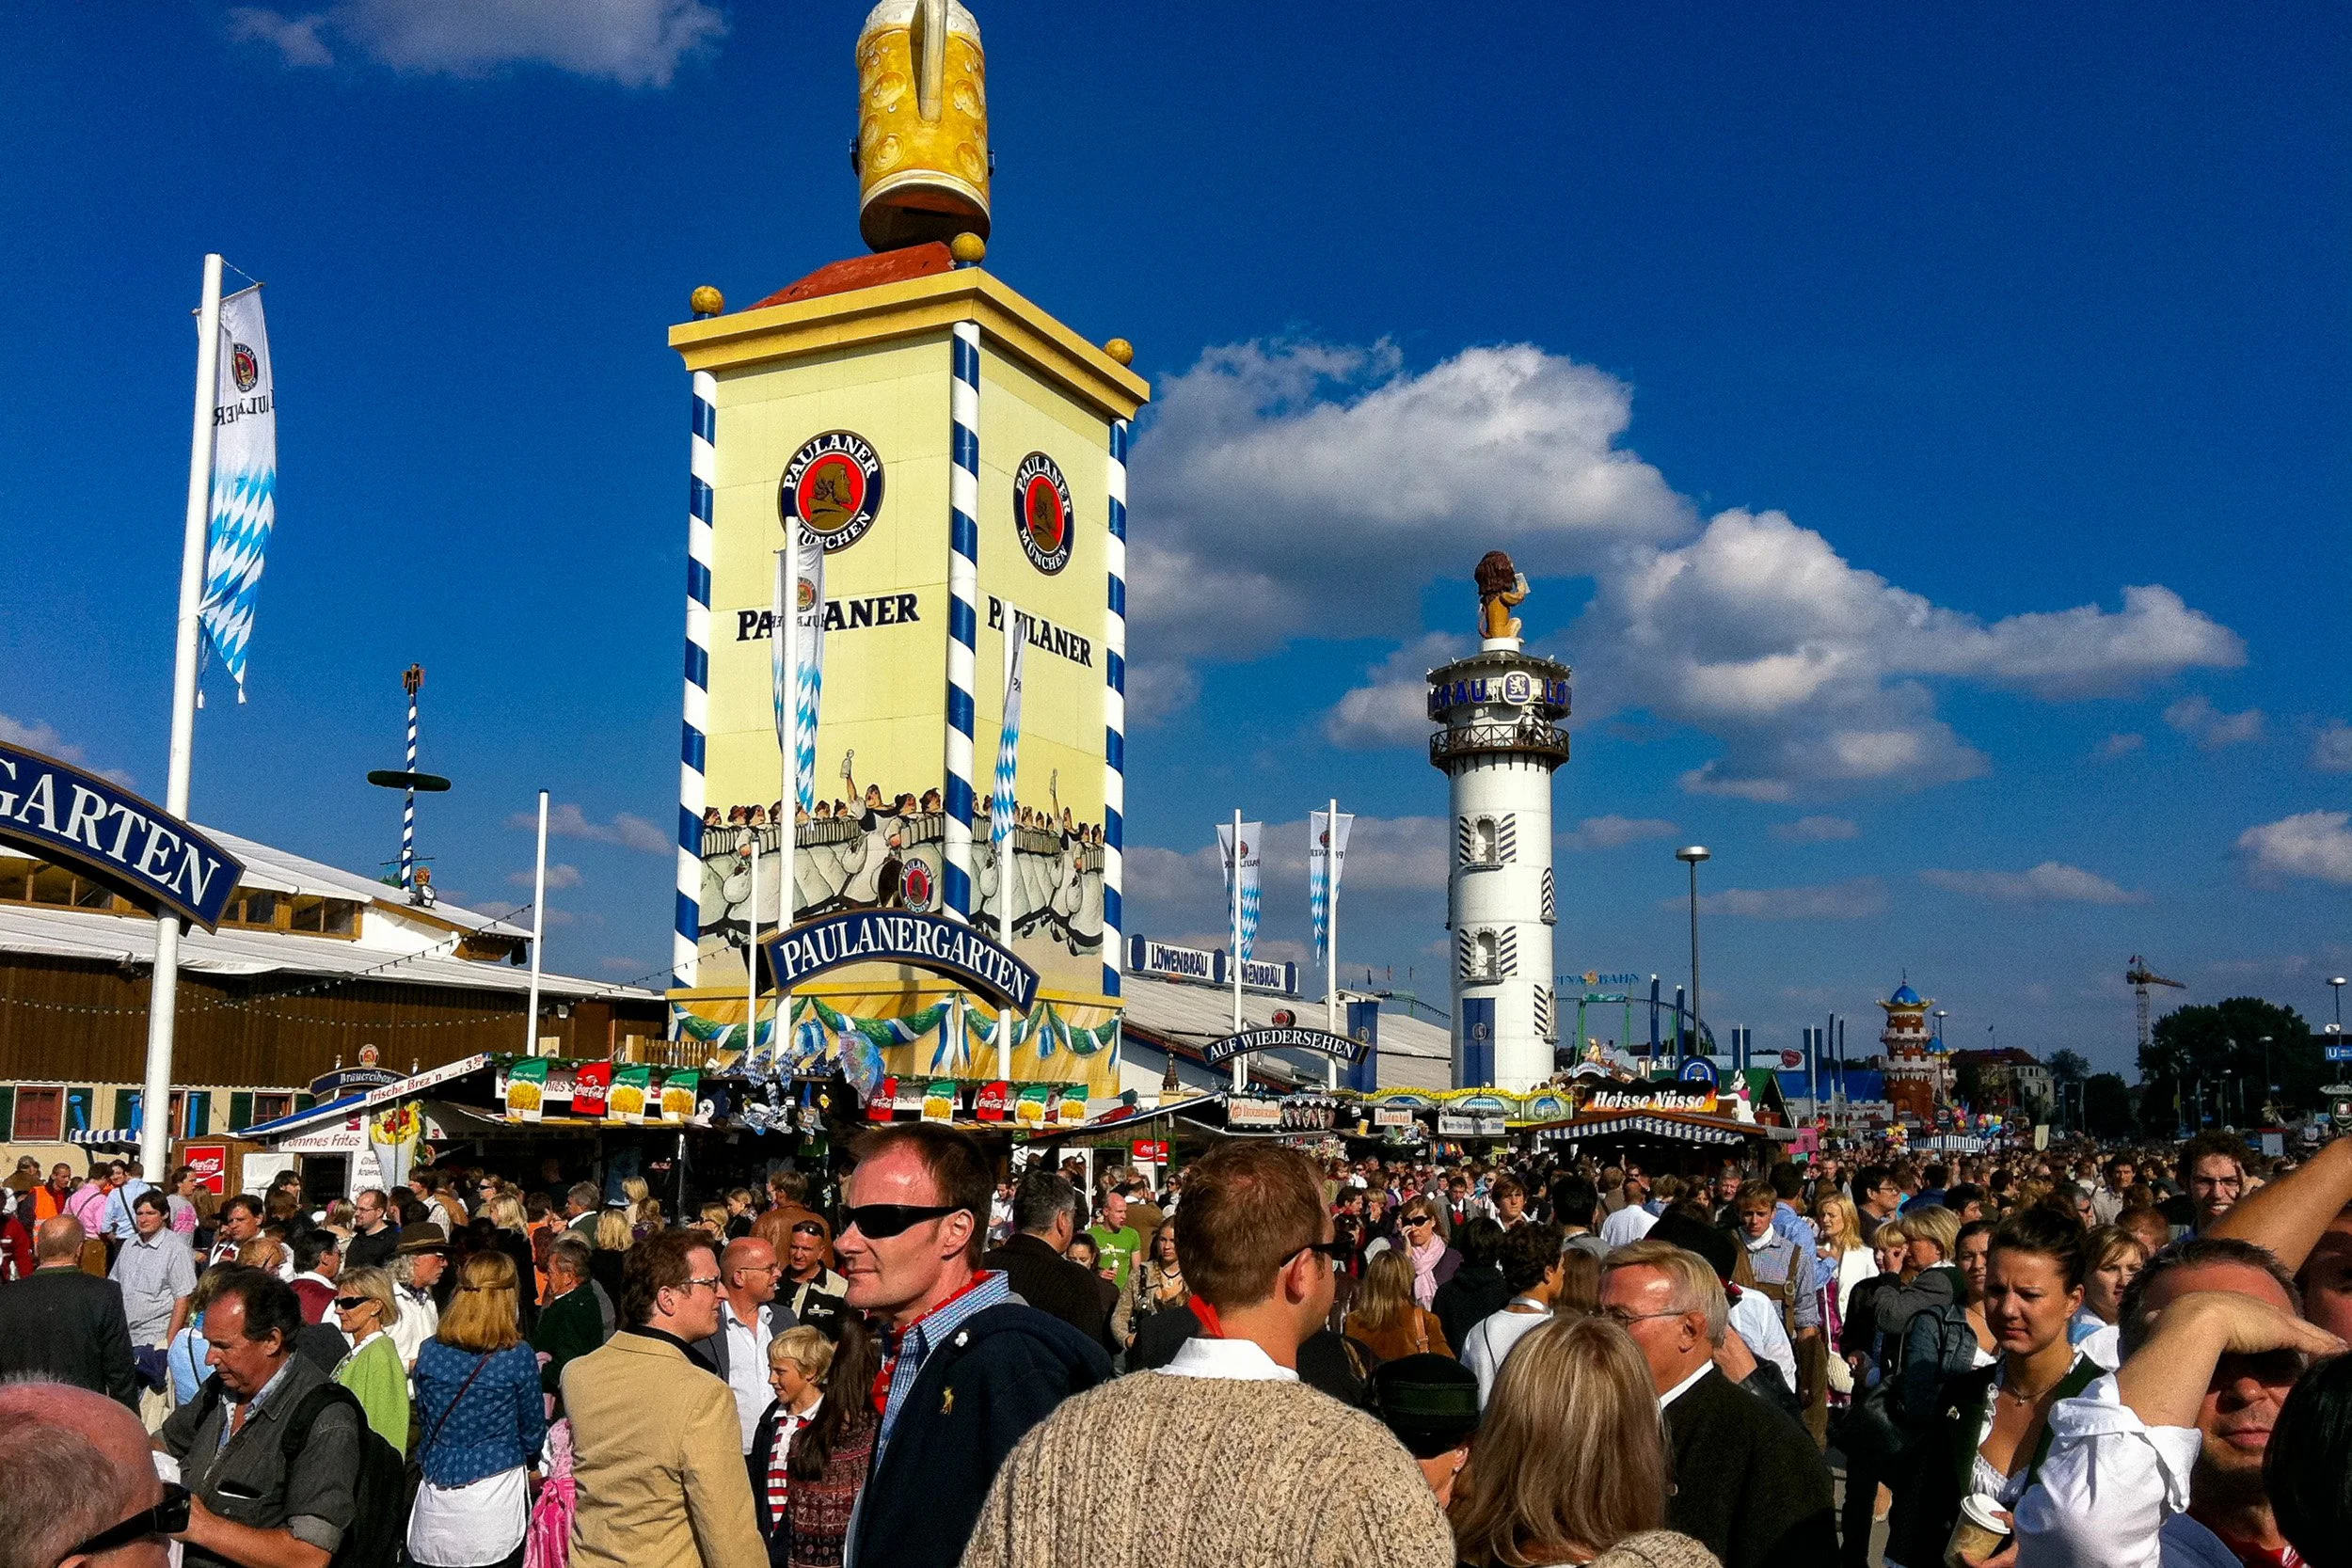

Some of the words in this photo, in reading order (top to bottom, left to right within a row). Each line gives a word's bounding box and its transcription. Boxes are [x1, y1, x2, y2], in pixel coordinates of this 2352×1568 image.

[783, 434, 879, 490] PAULANER
[1015, 455, 1072, 516] PAULANER
[736, 593, 920, 641] PAANER
[779, 916, 1031, 1005] PAULANERGARTEN
[1151, 943, 1208, 977] LÖWENBRÄU
[1210, 1037, 1238, 1061] AUF
[1240, 1029, 1357, 1059] WIEDERSEHEN
[2328, 1048, 2337, 1058] U
[370, 1085, 404, 1104] frische
[575, 1082, 606, 1099] Coca-Cola
[1594, 1091, 1650, 1108] Heisse
[1654, 1090, 1706, 1108] Nüsse
[282, 1135, 329, 1148] Pommes
[331, 1133, 361, 1147] Frites
[189, 1158, 220, 1173] Coca-Cola
